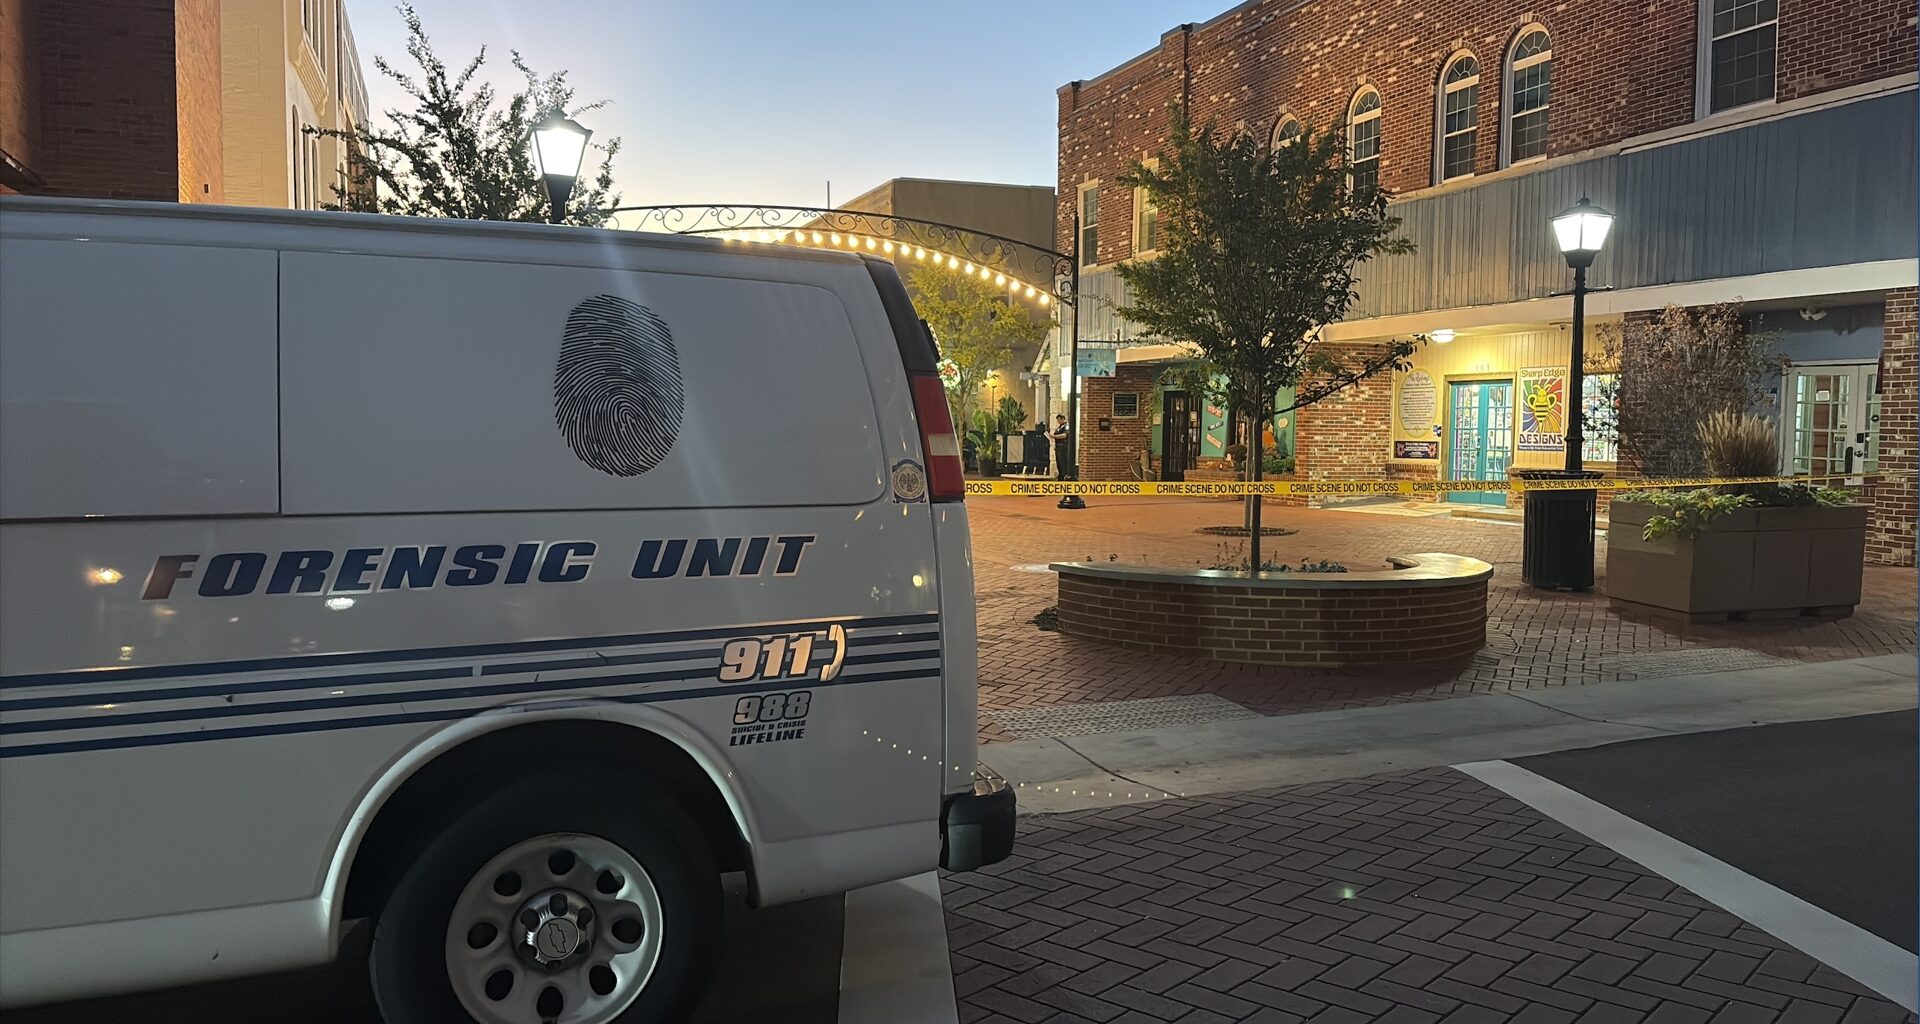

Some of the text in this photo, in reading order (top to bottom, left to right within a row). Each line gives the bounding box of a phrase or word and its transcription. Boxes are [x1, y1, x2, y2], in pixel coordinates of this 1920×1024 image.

[1521, 368, 1565, 378] Sharp Edge
[1519, 433, 1563, 444] DESIGNS
[965, 482, 993, 494] ROSS
[1010, 483, 1140, 494] CRIME SCENE DO NOT CROSS
[1156, 483, 1275, 494] CRIME SCENE DO NOT CROSS
[1290, 482, 1399, 493] CRIME SCENE DO NOT CROSS
[1412, 481, 1511, 492] CRIME SCENE DO NOT CROSS
[1523, 479, 1613, 490] CRIME SCENE DO NOT CROSS
[141, 534, 816, 601] FORENSIC UNIT
[718, 633, 816, 683] 911
[733, 690, 812, 726] 988
[731, 724, 766, 735] SUICIDE
[777, 720, 807, 729] CRISIS
[729, 728, 806, 747] LIFELINE
